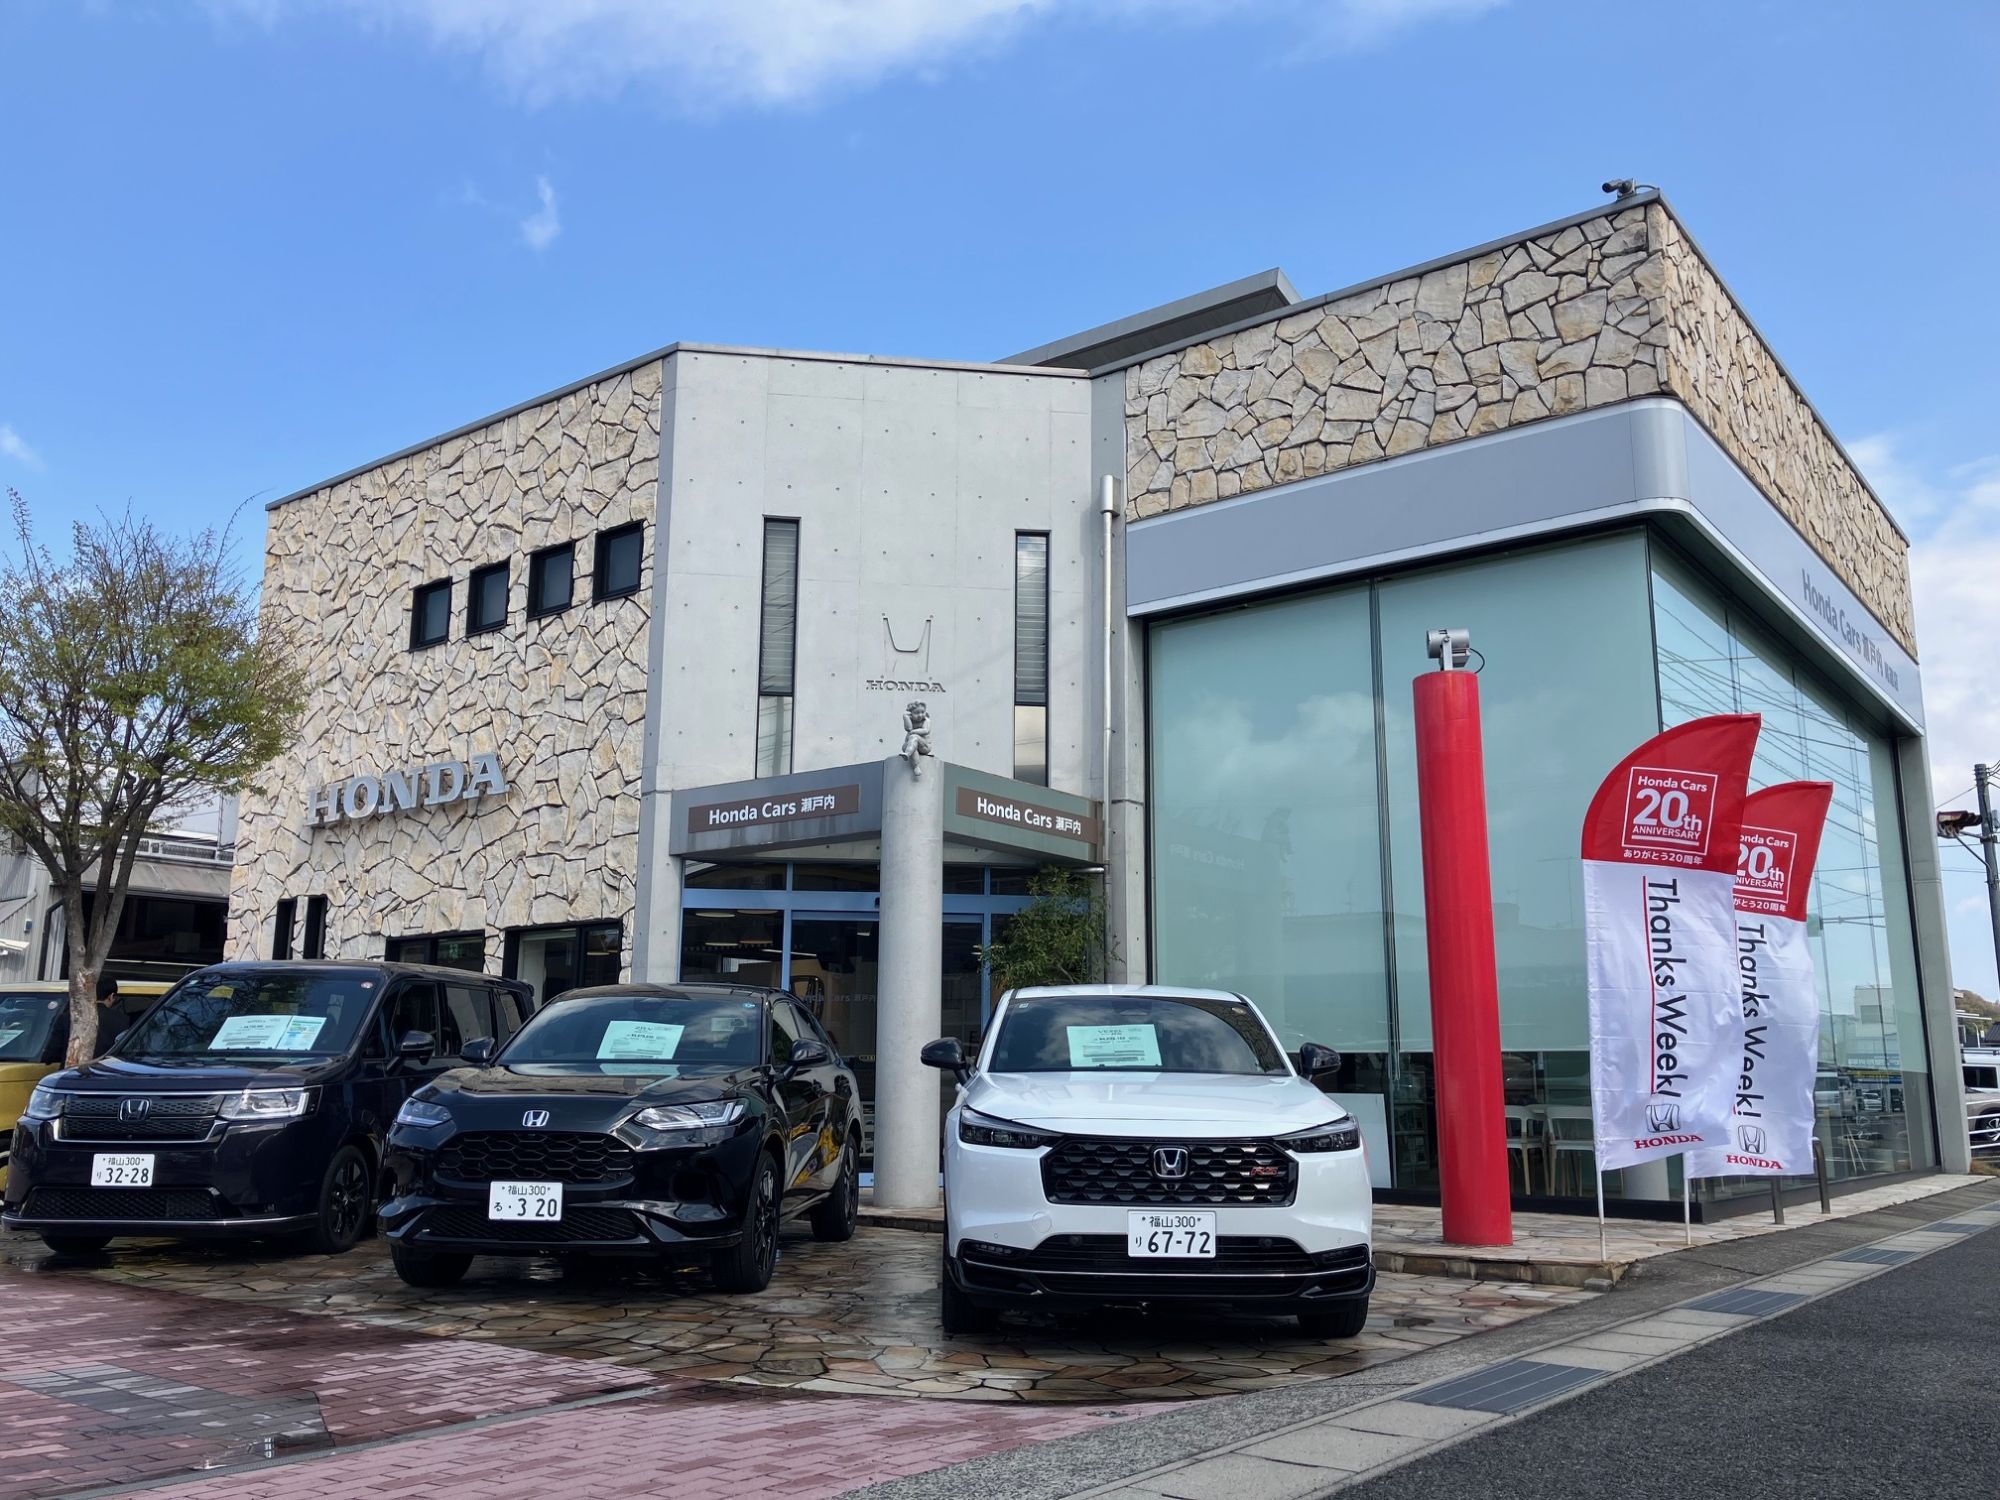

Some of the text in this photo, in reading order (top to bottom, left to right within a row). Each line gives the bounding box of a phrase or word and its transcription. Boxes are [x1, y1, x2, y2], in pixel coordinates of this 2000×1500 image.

[1802, 568, 1838, 632] Honda
[1840, 609, 1861, 655] Cars
[866, 680, 946, 692] HONDA
[304, 752, 510, 827] HONDA
[1638, 776, 1707, 792] Honda Cars
[709, 794, 835, 825] Honda Cars 瀬戸内
[977, 797, 1021, 821] Honda
[1024, 808, 1052, 828] Cars
[1633, 788, 1702, 831] 20th
[1632, 825, 1700, 840] ANNIVERSARY
[1766, 837, 1789, 848] Cars
[1623, 849, 1703, 864] ありがとう20周年
[1735, 877, 1784, 889] NIVERSARY
[1648, 879, 1687, 987] Thanks
[1738, 924, 1770, 1018] Thanks
[1634, 1134, 1704, 1149] HONDA
[1725, 1154, 1783, 1170] HONDA
[105, 1167, 149, 1183] 32-28
[494, 1202, 503, 1212] る
[1148, 1231, 1211, 1254] 67-72
